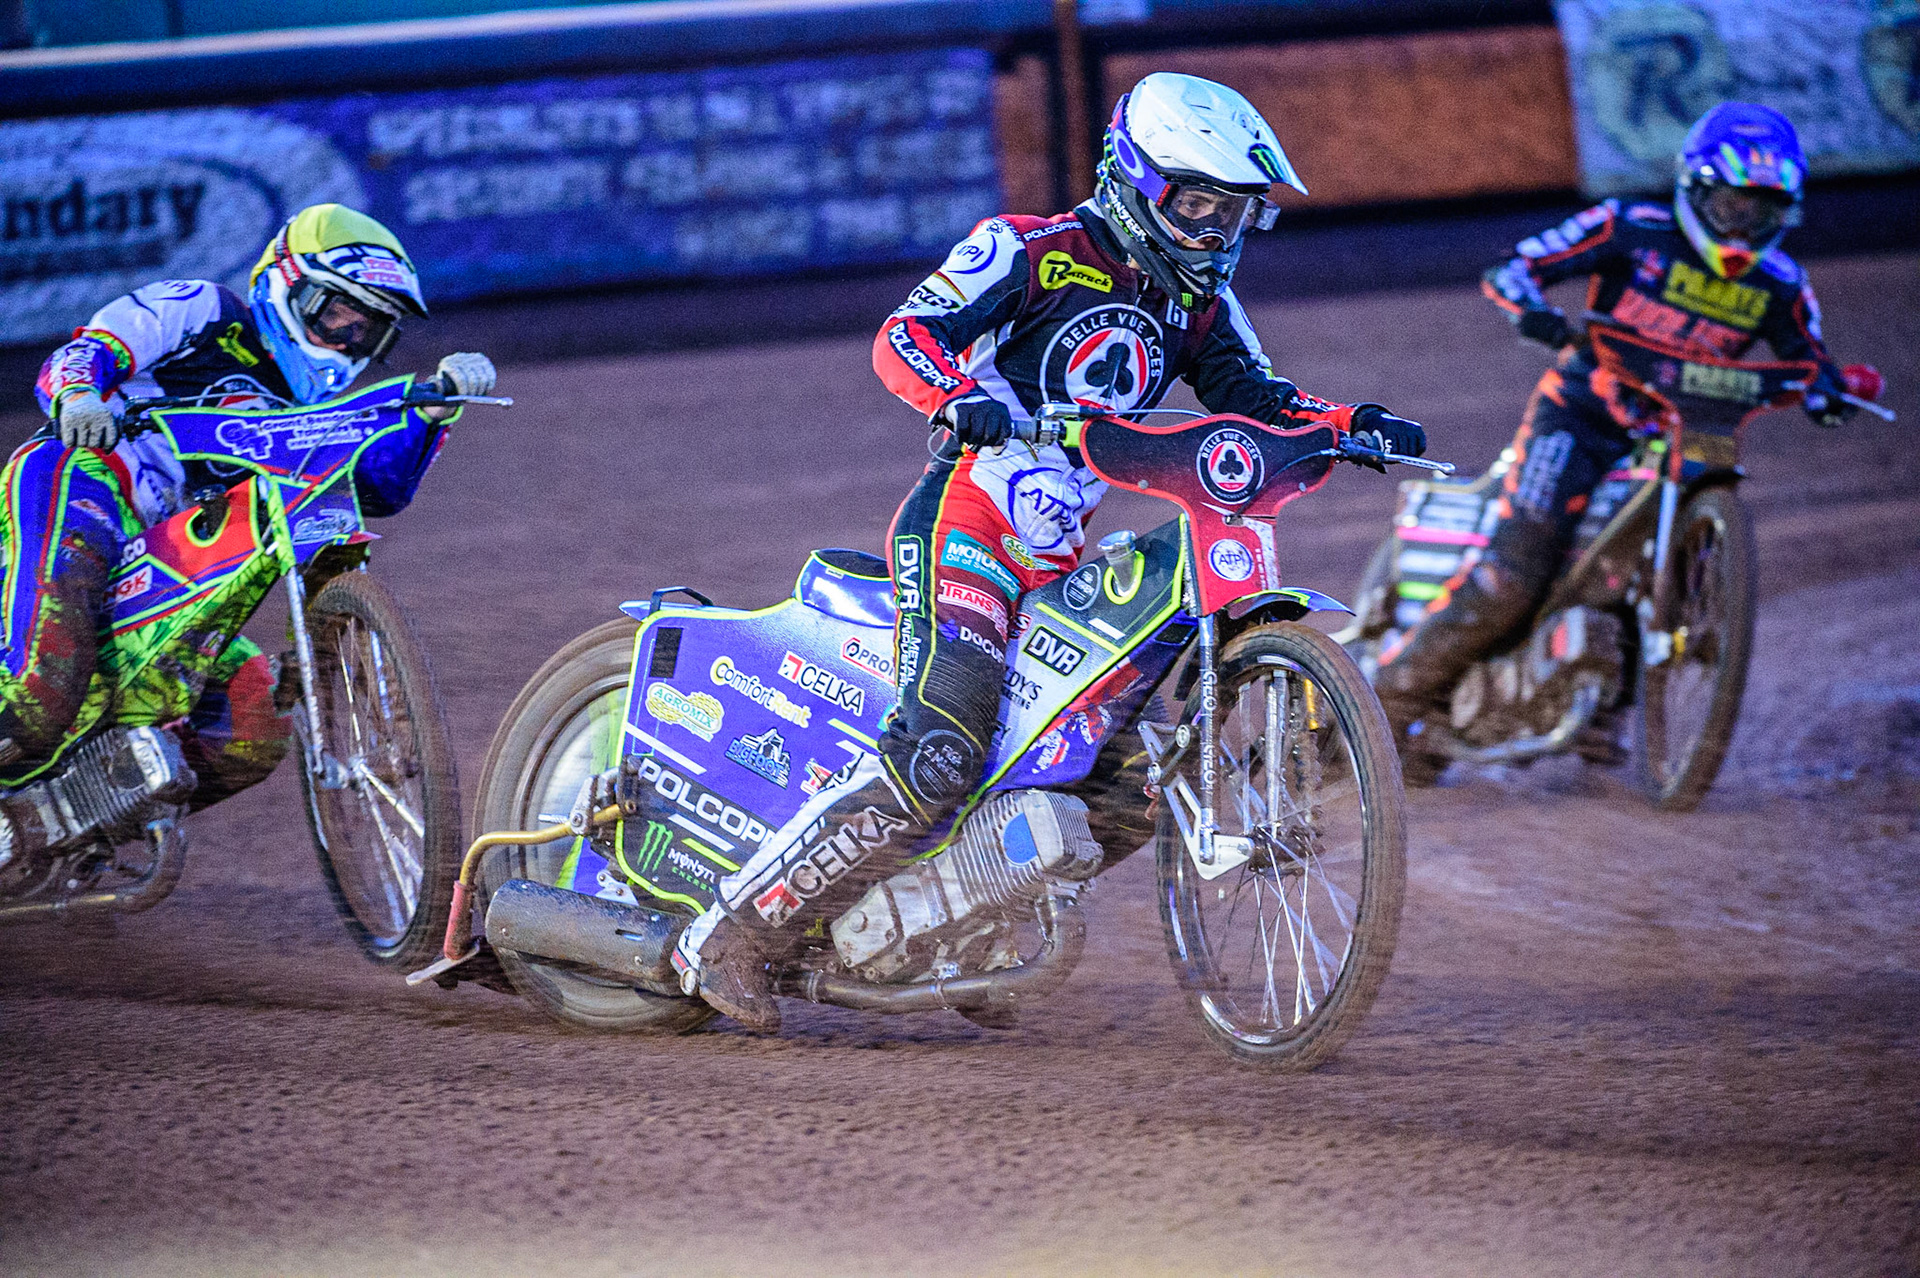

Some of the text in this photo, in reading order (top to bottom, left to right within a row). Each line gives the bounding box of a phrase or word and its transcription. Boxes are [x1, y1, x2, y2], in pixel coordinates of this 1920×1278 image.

[1060, 311, 1162, 379] BELLE VUE ACES
[1201, 432, 1259, 460] BELLE VUE ACES
[898, 542, 921, 611] DVR
[946, 541, 1020, 589] MOTOR
[896, 618, 913, 706] INDUSTRI
[1028, 628, 1083, 674] DVR
[653, 687, 716, 729] AGROMIX
[799, 663, 865, 715] CELKA
[727, 739, 786, 779] BIGFOOT
[787, 806, 910, 899] CELKA
